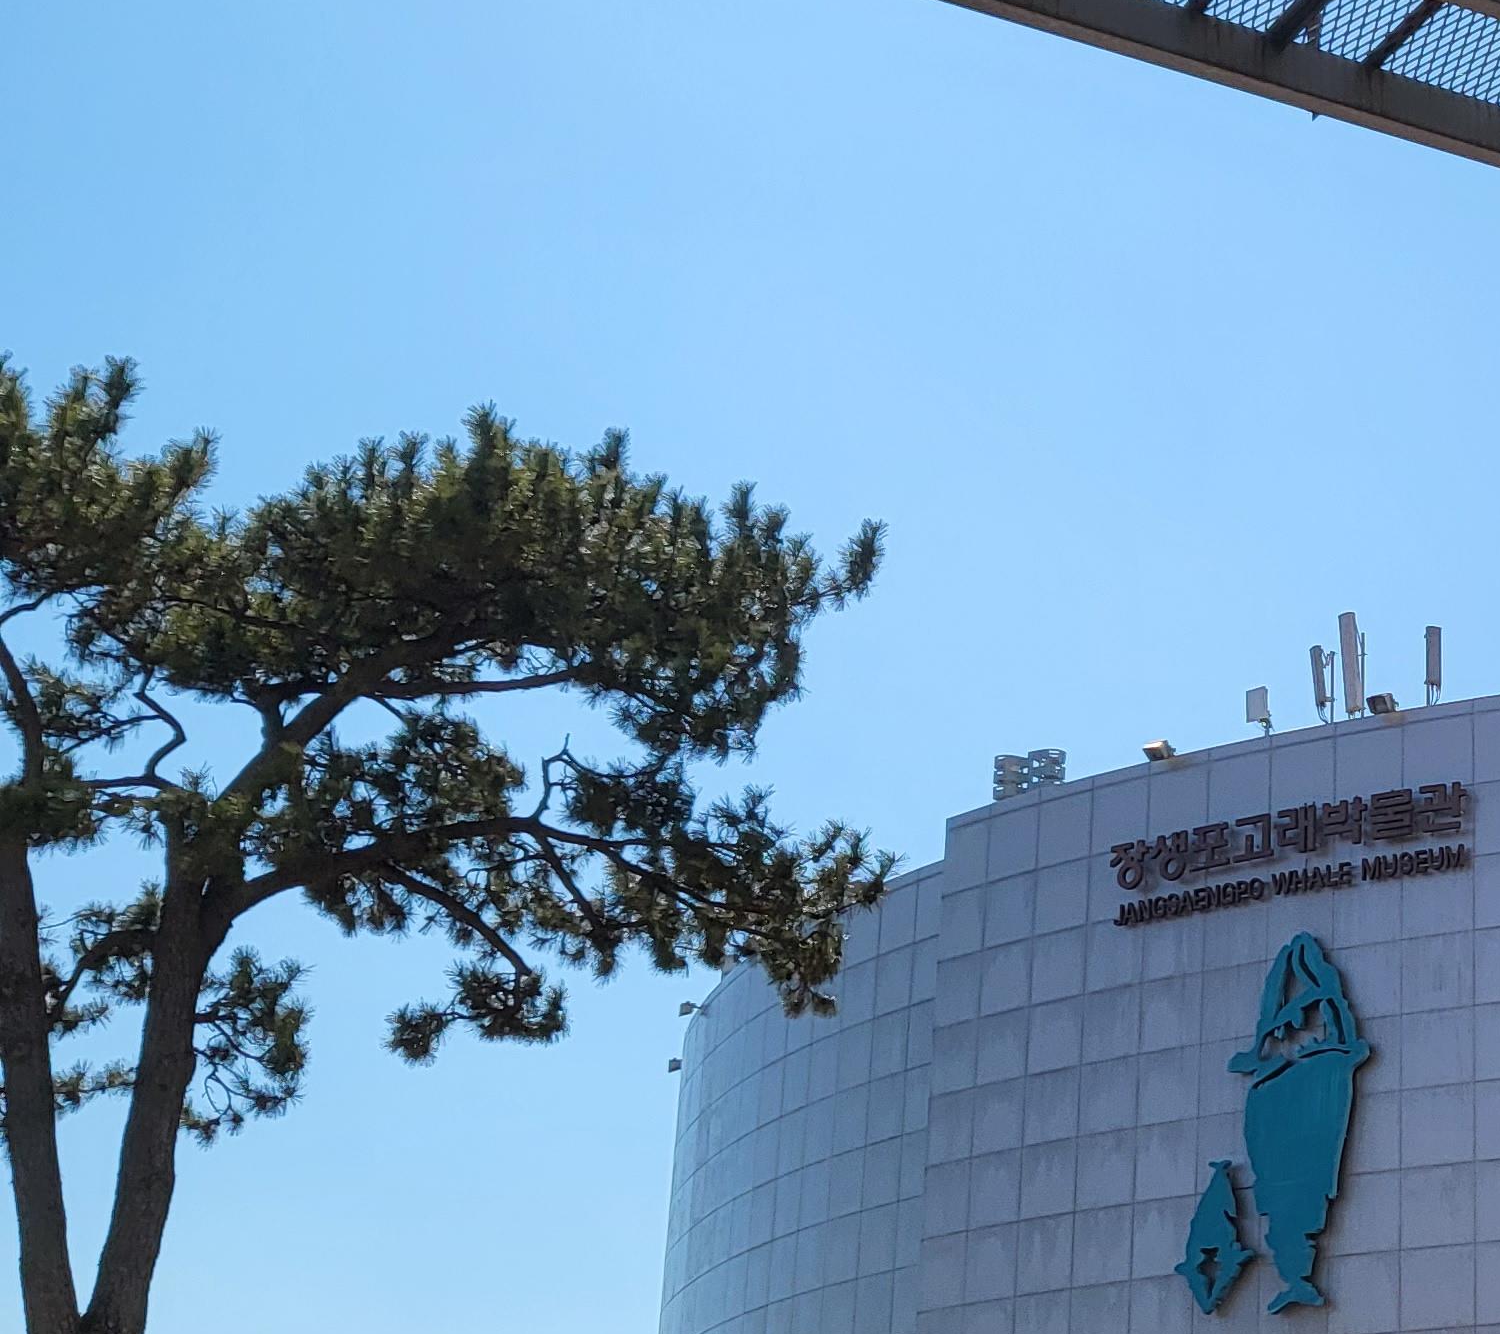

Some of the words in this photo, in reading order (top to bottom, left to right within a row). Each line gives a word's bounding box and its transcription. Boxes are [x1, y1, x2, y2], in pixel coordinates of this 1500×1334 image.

[1110, 781, 1468, 891] 장생포고래박물관
[1114, 878, 1265, 926] JANGSAENGPO
[1272, 861, 1353, 896] WHALE
[1362, 843, 1466, 881] MUSEUM
